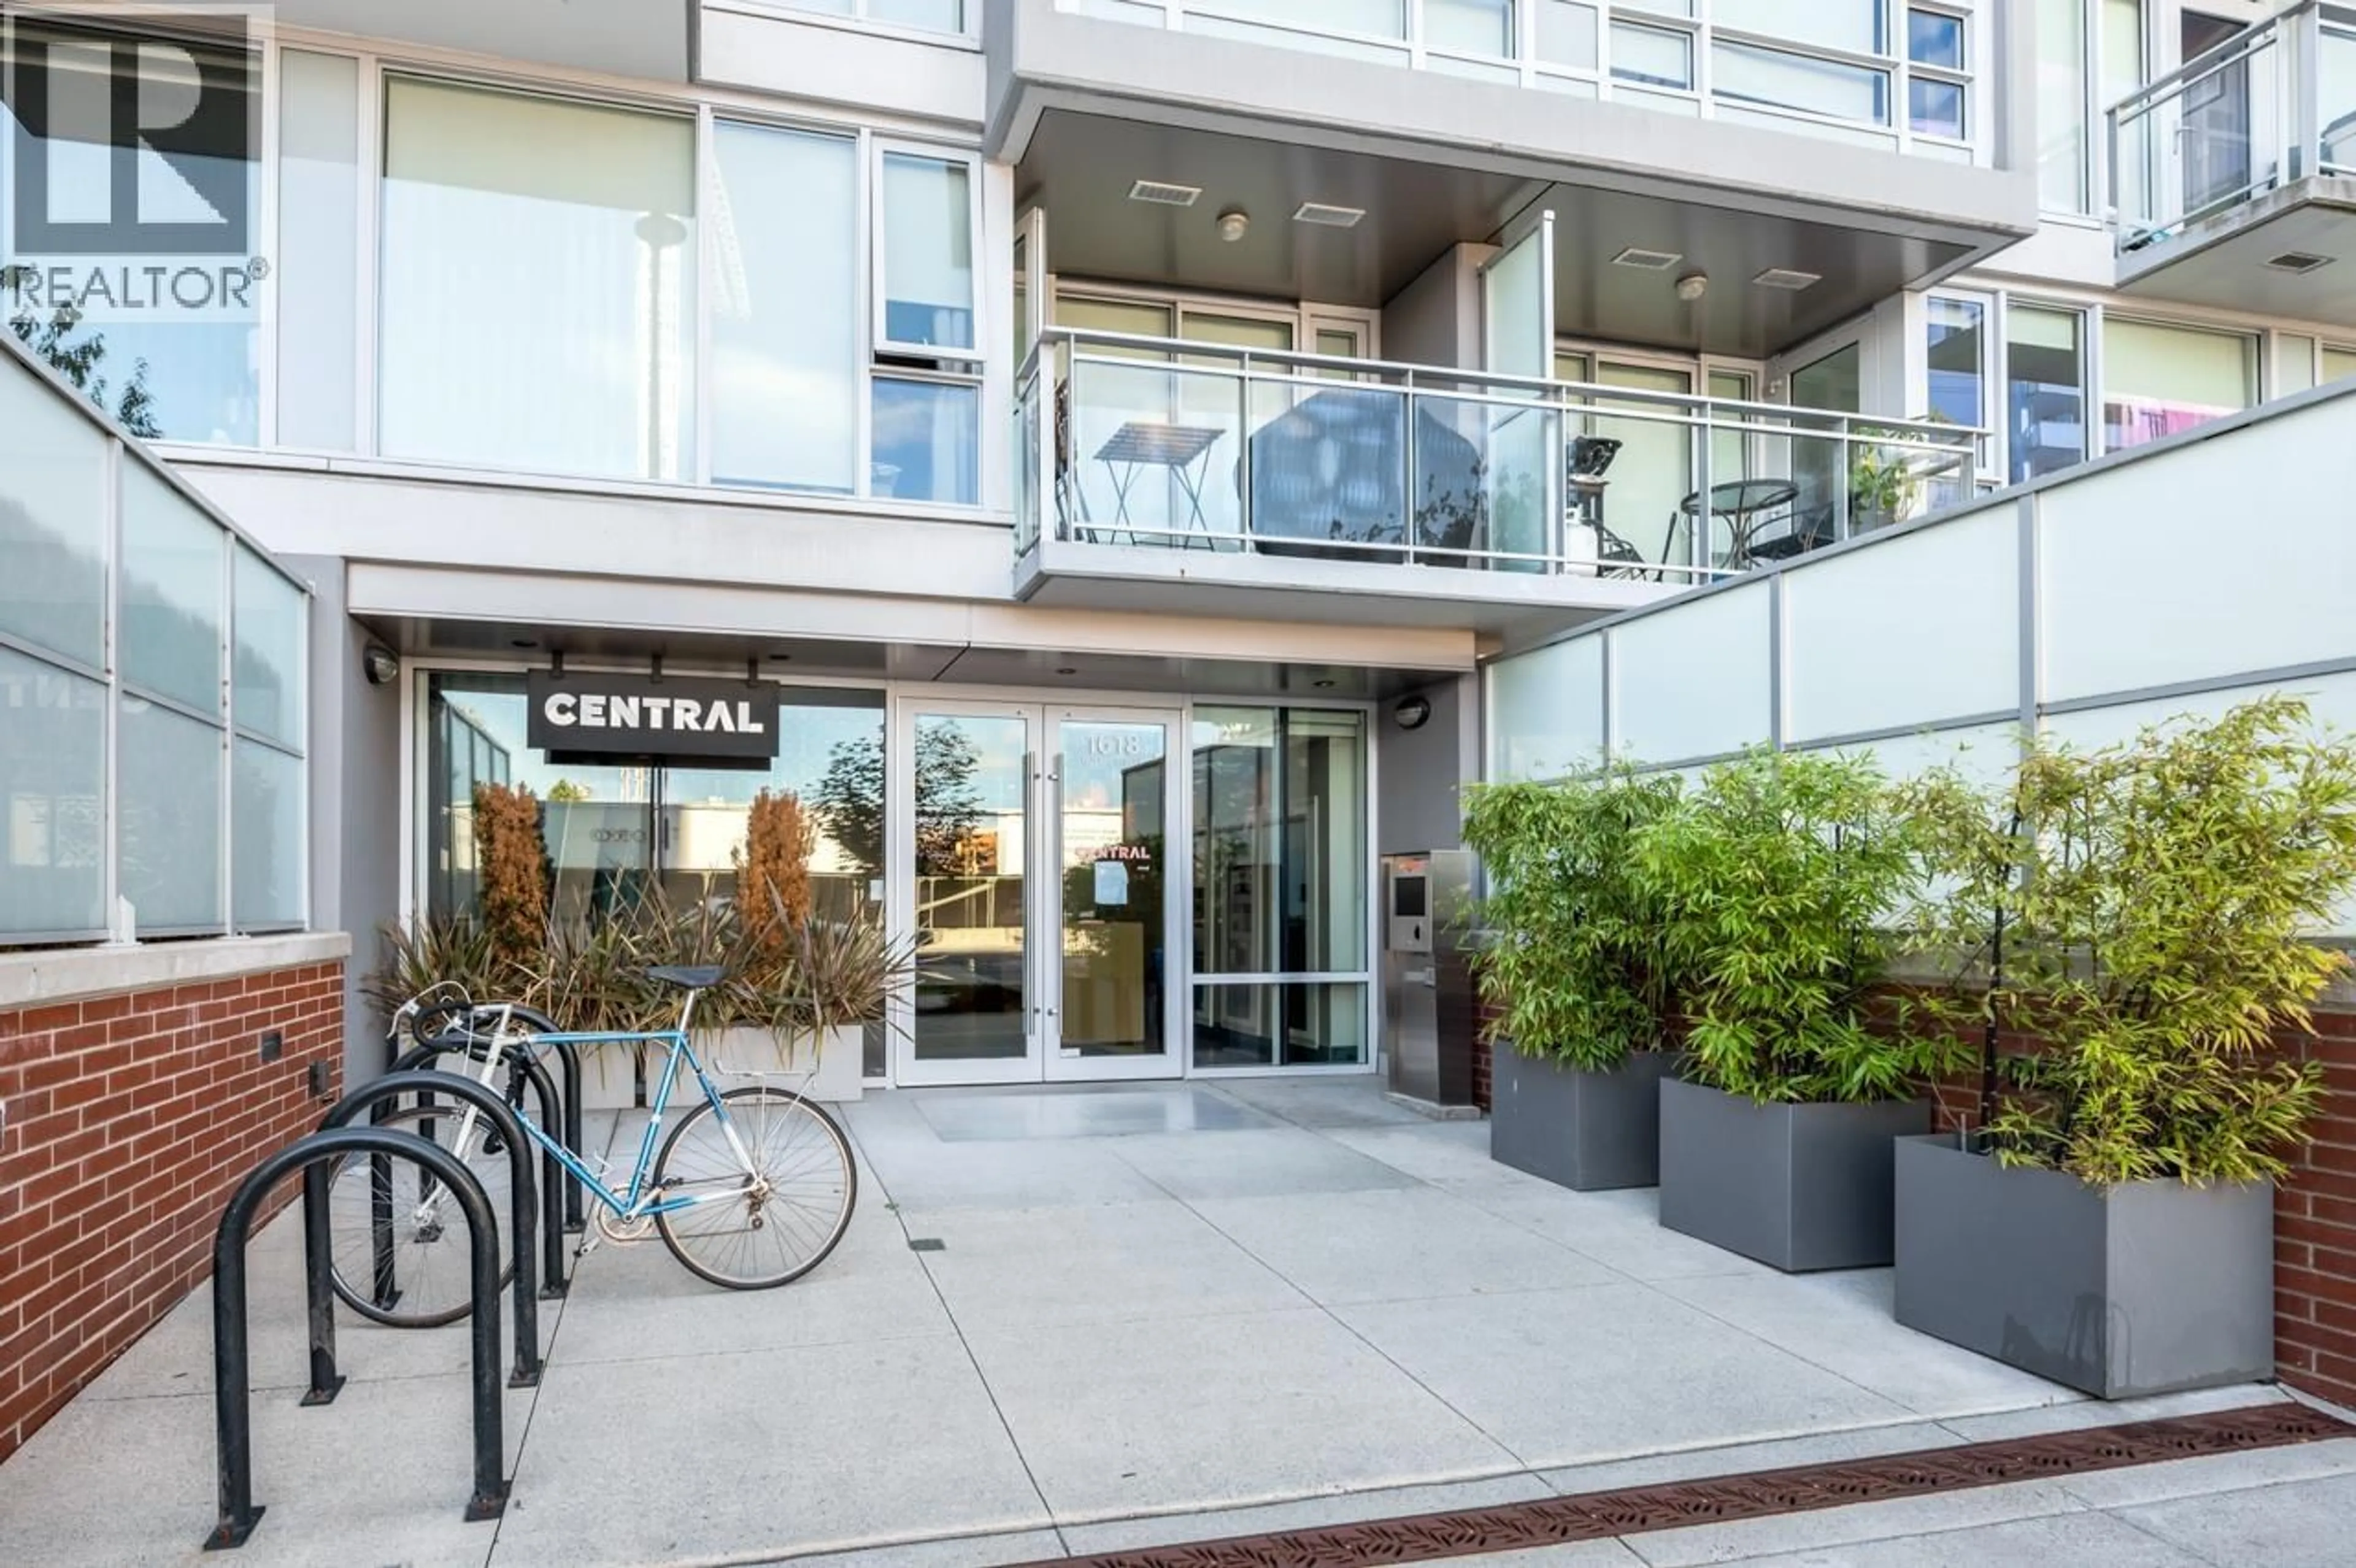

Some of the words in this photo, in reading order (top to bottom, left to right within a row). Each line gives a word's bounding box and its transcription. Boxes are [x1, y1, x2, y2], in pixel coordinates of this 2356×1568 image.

[544, 692, 764, 733] CENTRAL
[1088, 734, 1140, 755] 1618
[1076, 846, 1151, 859] NTRAL
